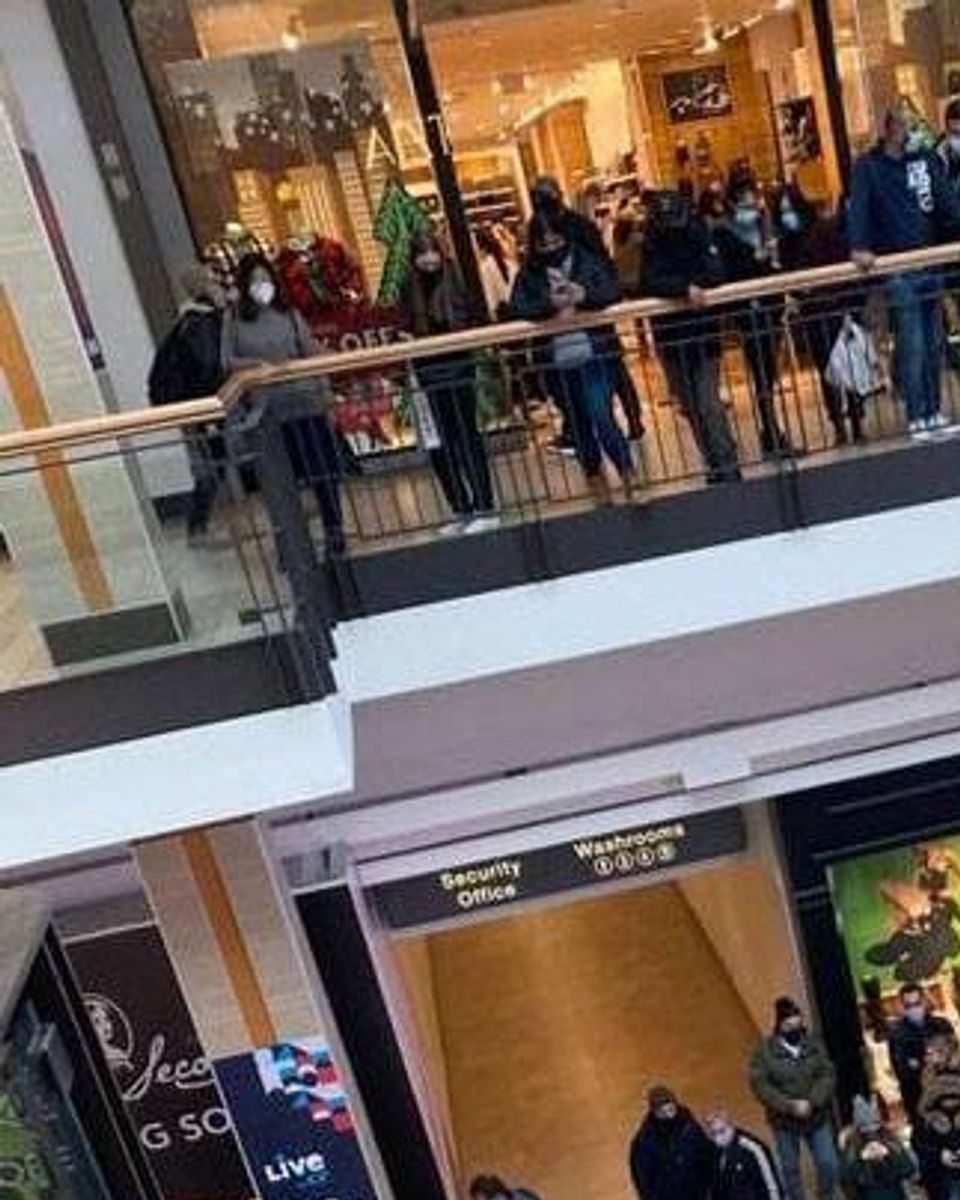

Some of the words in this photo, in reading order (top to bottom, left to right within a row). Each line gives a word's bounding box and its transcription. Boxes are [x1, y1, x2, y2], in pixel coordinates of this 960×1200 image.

[573, 822, 687, 860] Washrooms
[439, 857, 521, 890] Security
[457, 883, 517, 908] Office
